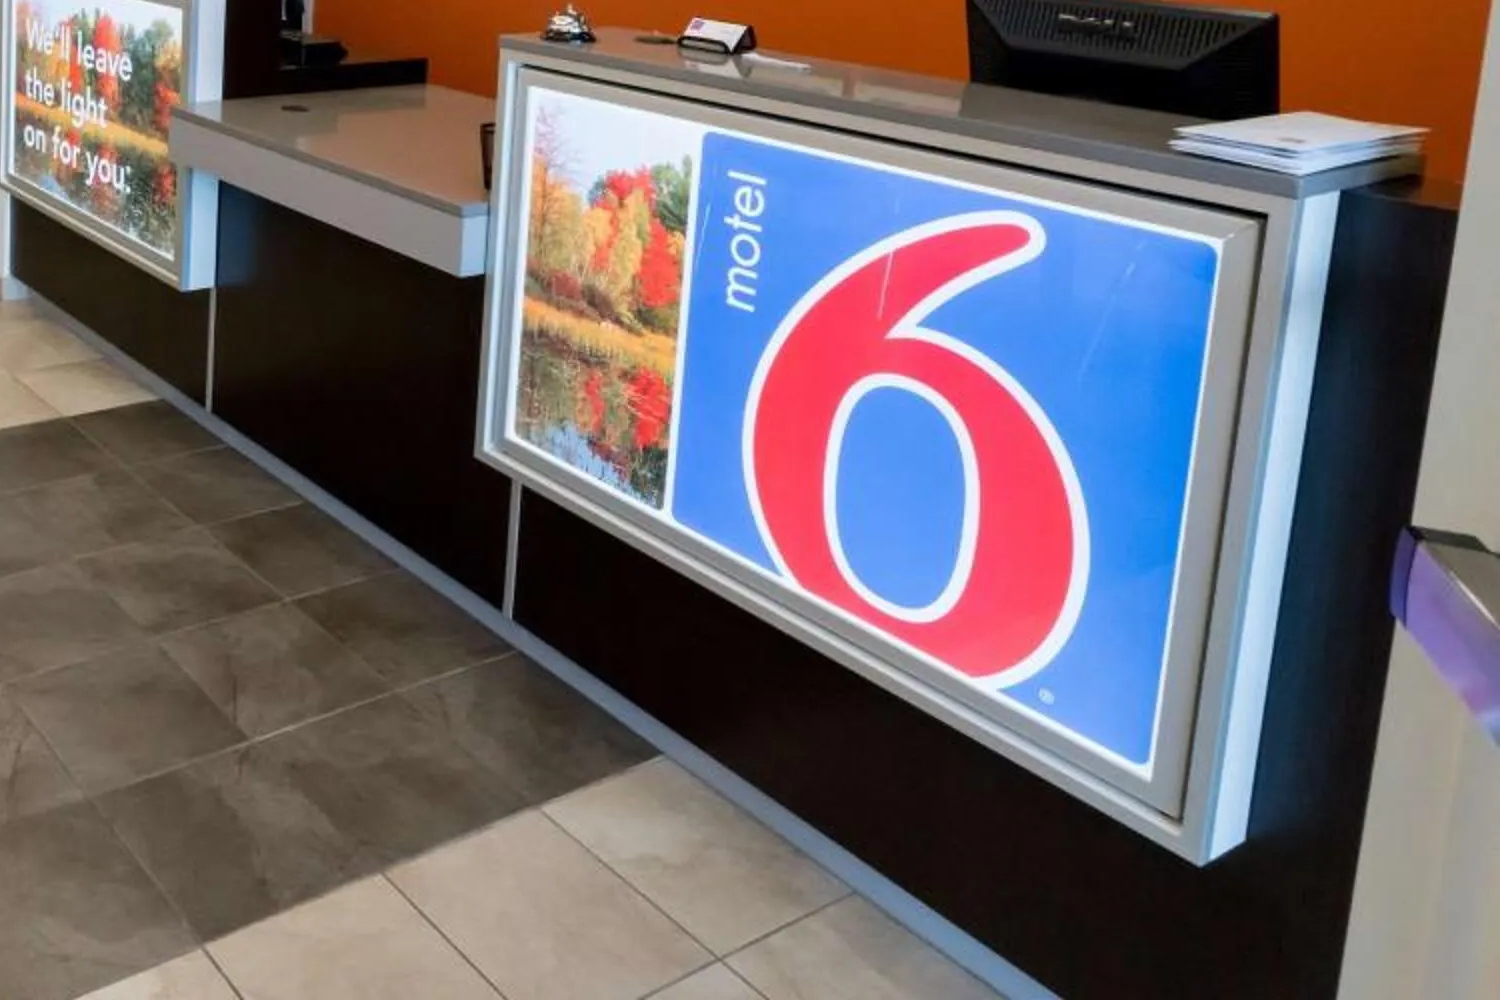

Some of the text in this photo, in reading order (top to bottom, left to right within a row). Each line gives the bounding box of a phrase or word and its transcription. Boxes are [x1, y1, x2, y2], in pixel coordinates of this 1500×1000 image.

[26, 18, 134, 82] We'll leave
[25, 67, 108, 129] the light
[23, 123, 46, 154] on
[51, 124, 81, 169] for
[724, 169, 1091, 691] motel 6
